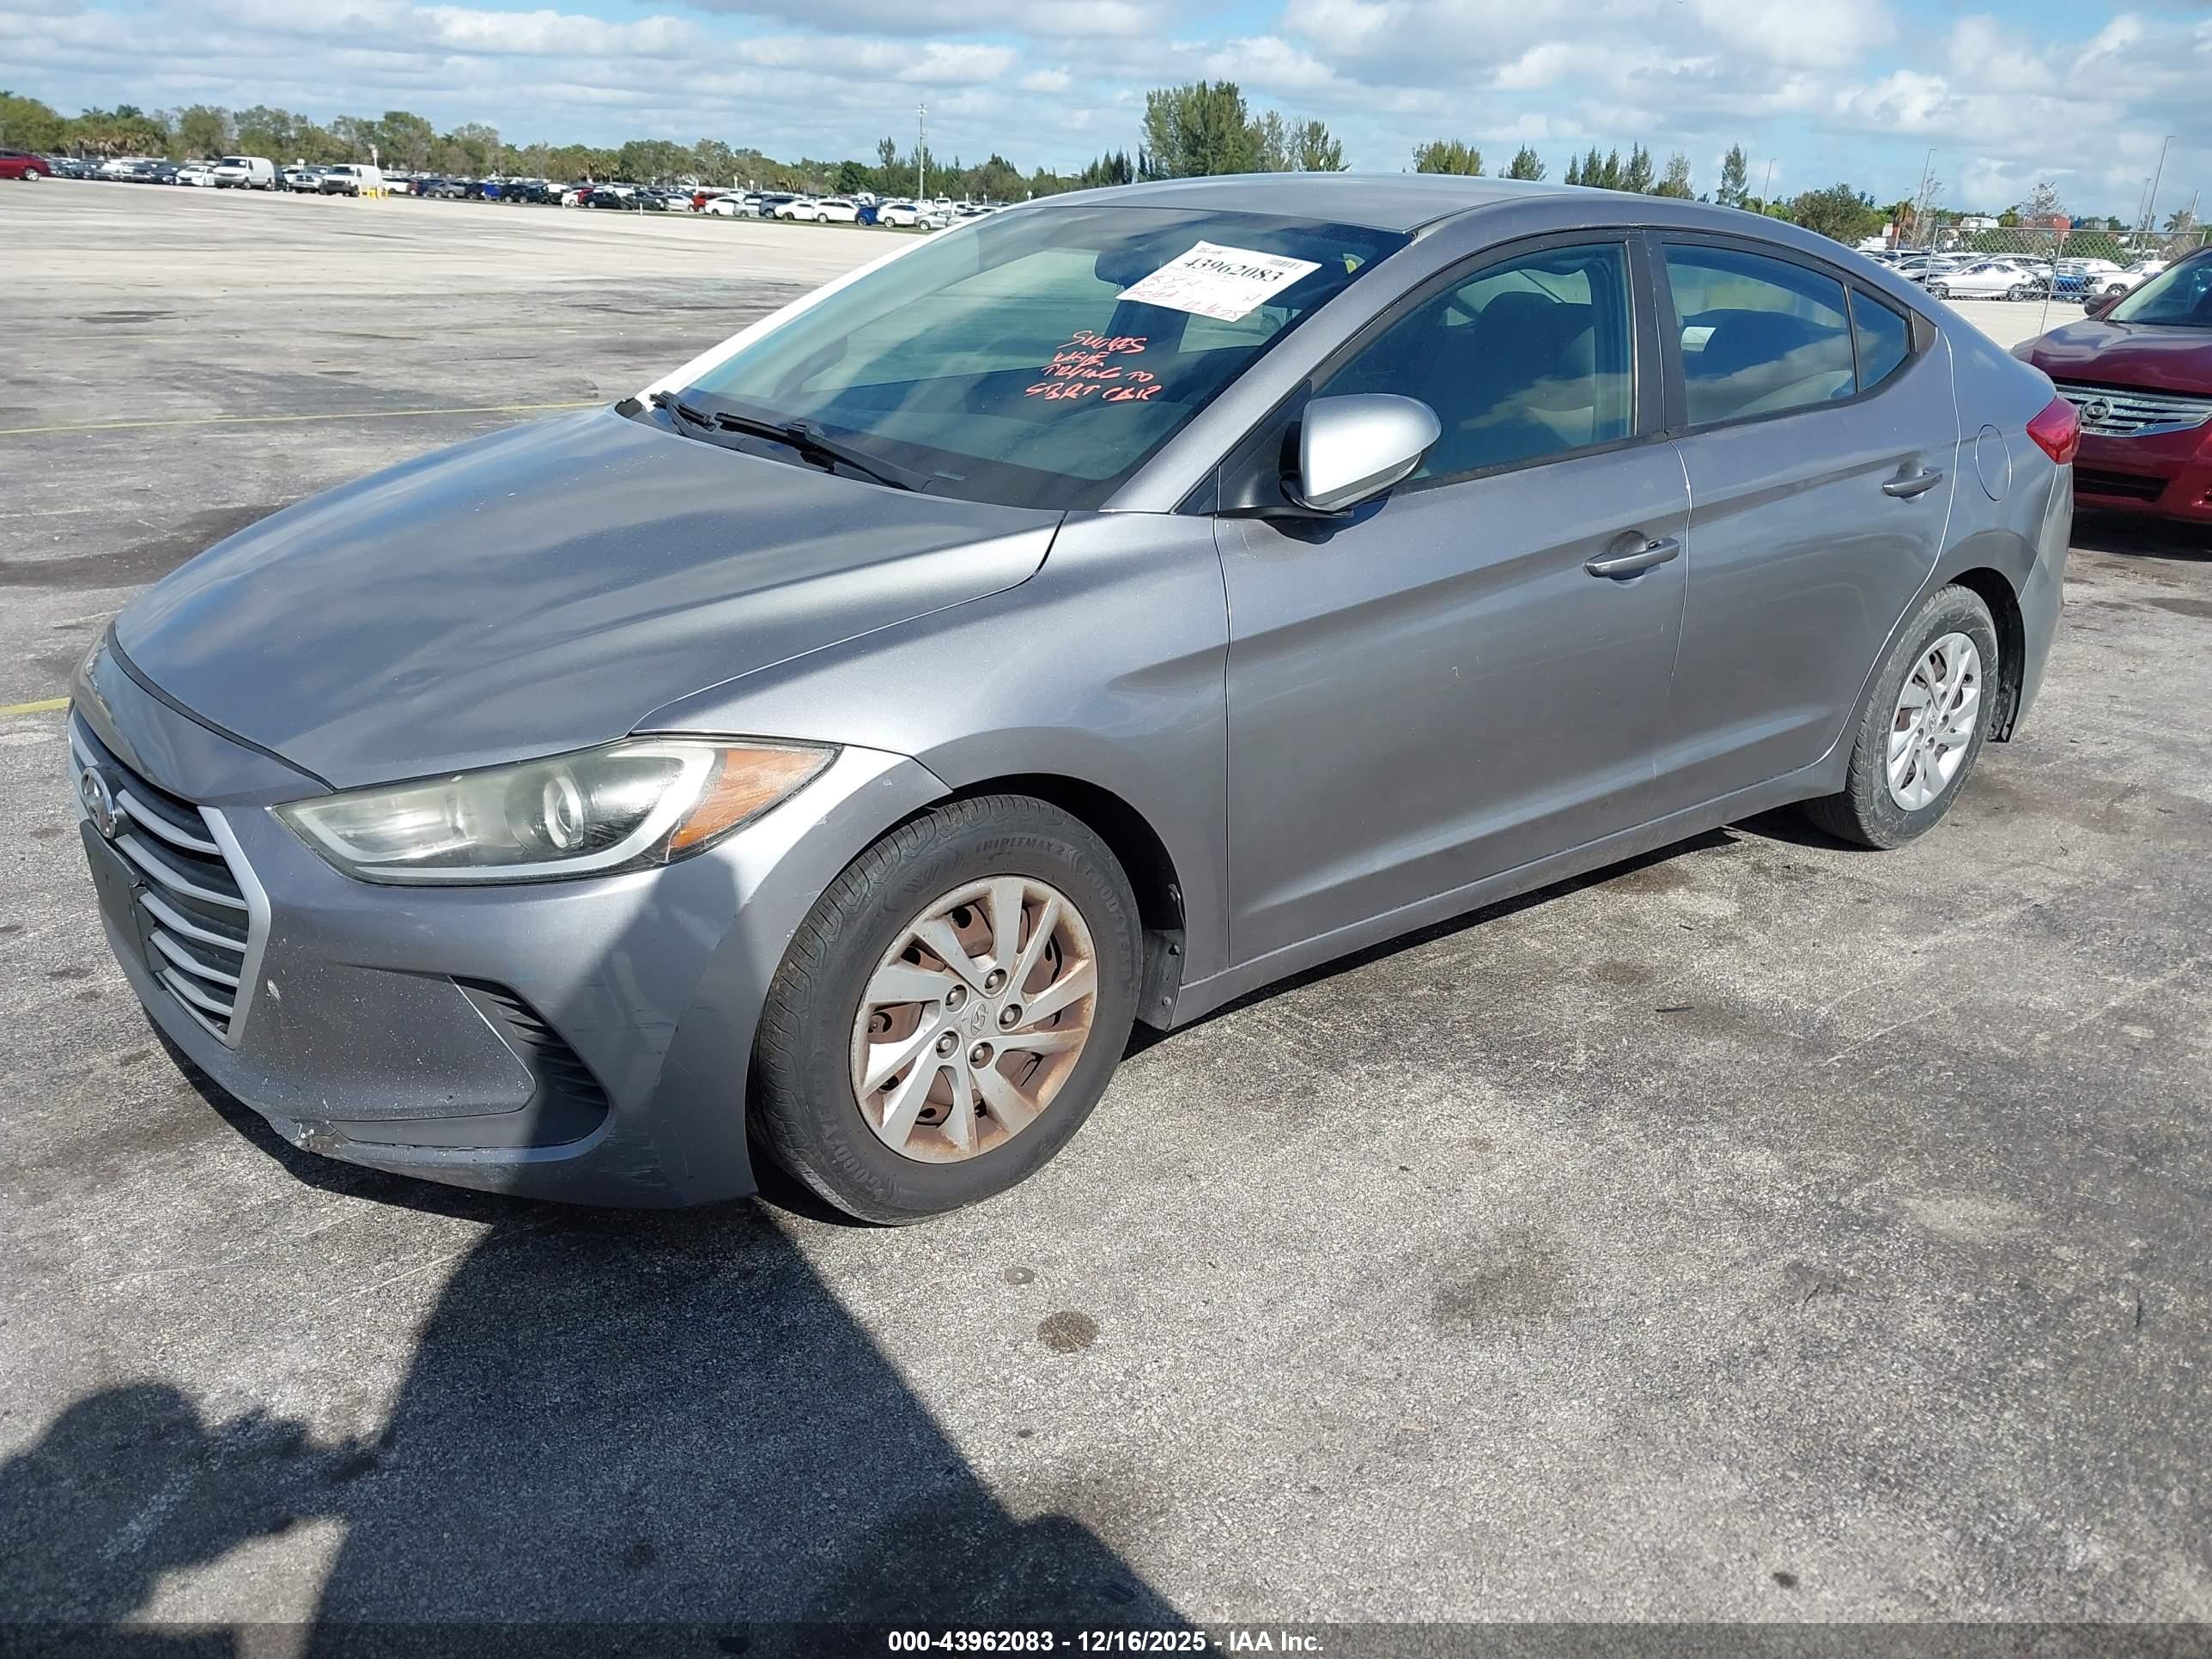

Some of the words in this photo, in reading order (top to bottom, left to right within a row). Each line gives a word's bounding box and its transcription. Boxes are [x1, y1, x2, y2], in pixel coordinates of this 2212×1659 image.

[1184, 257, 1285, 282] 43962083
[1041, 363, 1122, 380] TRYING
[1125, 371, 1154, 383] TO
[1024, 382, 1101, 400] START
[1102, 385, 1162, 402] CAR
